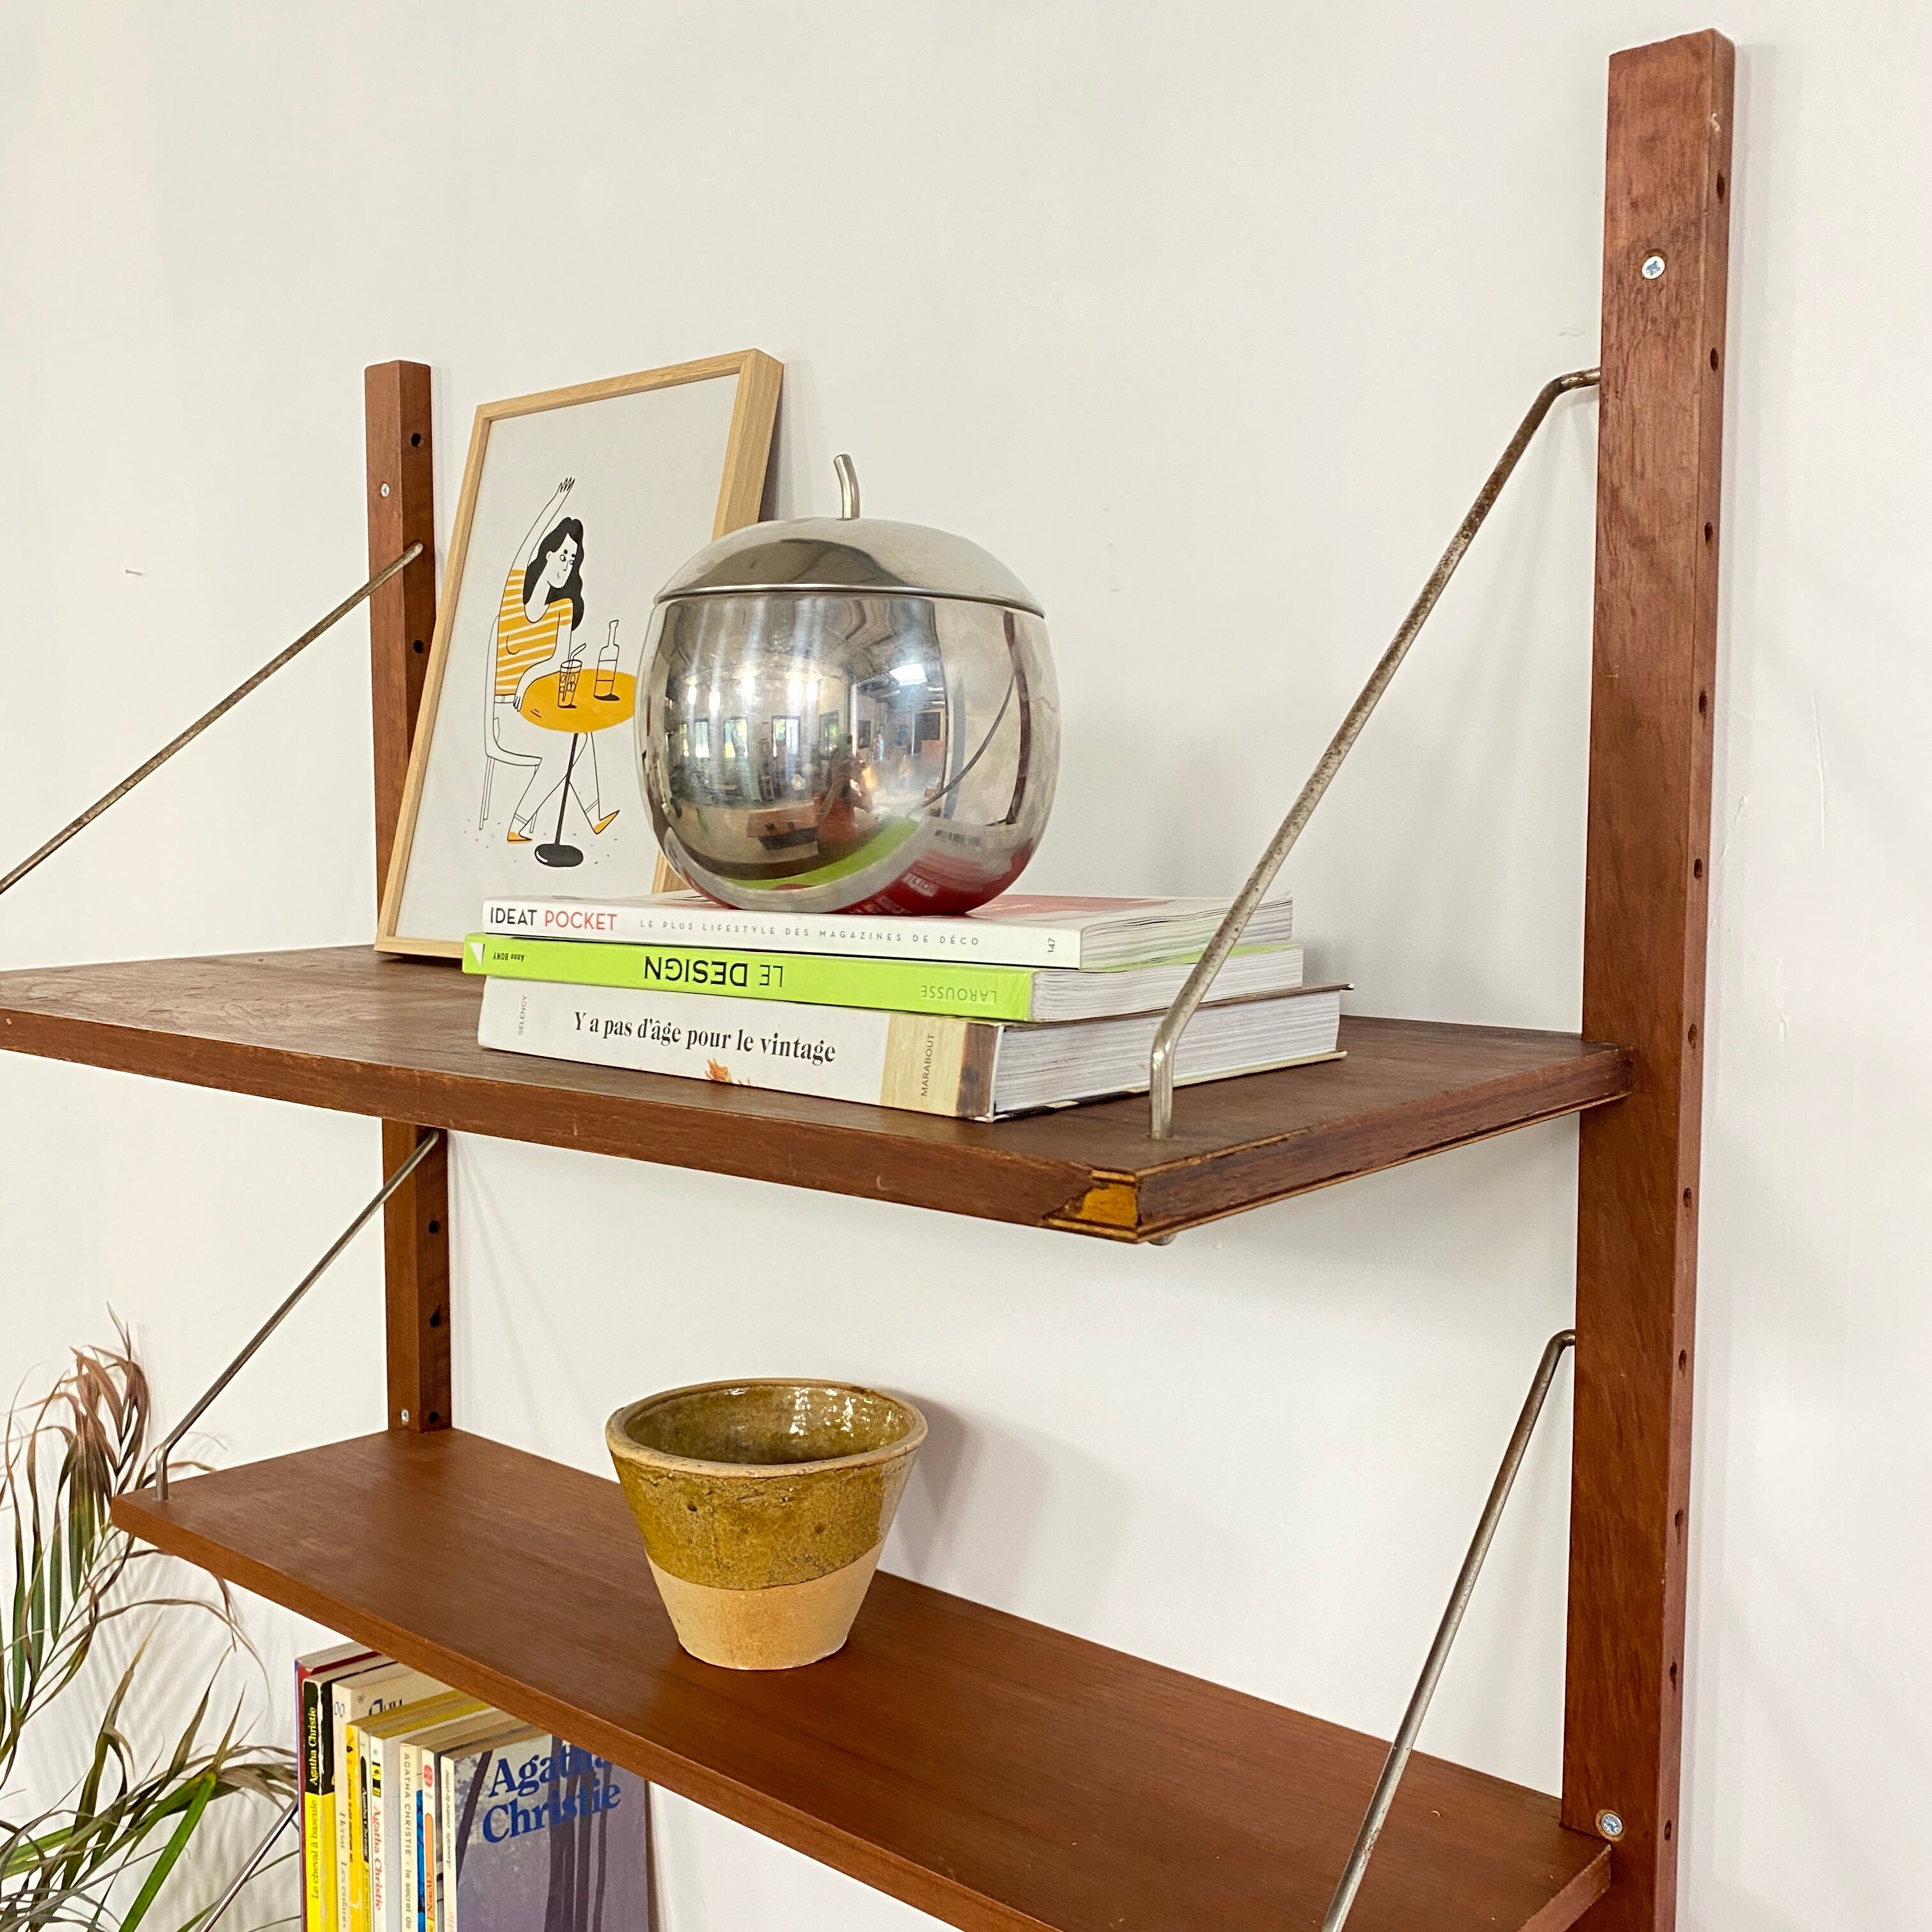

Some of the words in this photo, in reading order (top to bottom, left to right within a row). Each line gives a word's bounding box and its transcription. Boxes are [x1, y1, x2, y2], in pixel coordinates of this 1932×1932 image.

[489, 907, 538, 926] IDEAT
[544, 910, 618, 931] POCKET
[640, 920, 654, 928] LE
[663, 921, 694, 931] PLUS
[702, 923, 776, 935] LIFESTYLE
[785, 928, 810, 937] DES
[818, 930, 902, 942] MAGAZINES
[912, 934, 929, 944] DE
[939, 933, 980, 946] DÉCO
[493, 952, 509, 962] BONY
[510, 953, 525, 962] Anne
[1046, 937, 1057, 954] 147
[644, 956, 749, 988] DESIGN
[759, 965, 784, 988] LE
[920, 985, 997, 1004] LAROUSSE
[517, 995, 528, 1036] SELENCY
[574, 1011, 588, 1032] Y
[589, 1019, 599, 1033] a
[602, 1020, 632, 1040] pas
[638, 1018, 682, 1047] d'âge
[685, 1032, 732, 1051] pour
[736, 1028, 754, 1052] le
[760, 1031, 836, 1066] vintage
[920, 1033, 935, 1097] MARABOUT
[308, 1706, 318, 1747] Christie
[309, 1750, 319, 1785] Agatha
[309, 1799, 318, 1839] bascule
[483, 1778, 622, 1843] Christie
[372, 1806, 382, 1853] Agatha
[310, 1850, 319, 1884] cheval
[405, 1869, 411, 1879] le
[311, 1885, 319, 1899] Le
[374, 1858, 383, 1912] Christie
[406, 1917, 411, 1929] de
